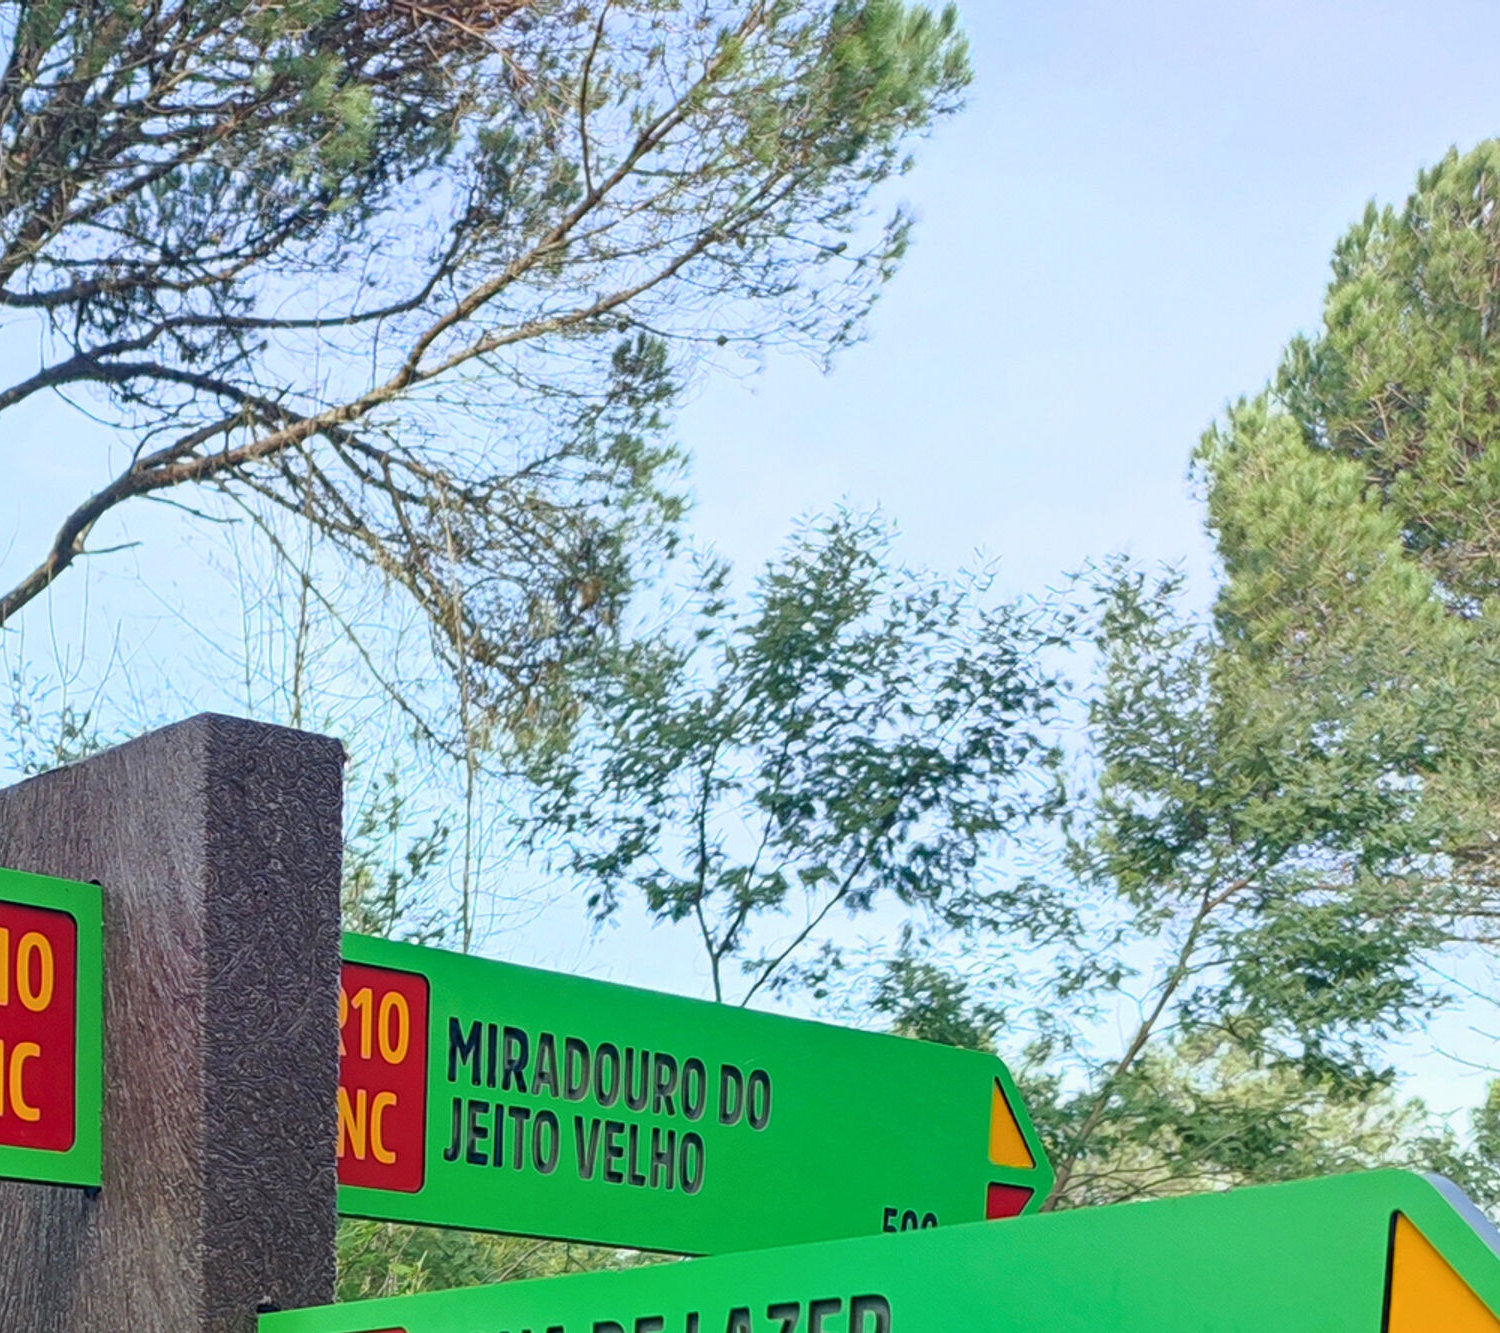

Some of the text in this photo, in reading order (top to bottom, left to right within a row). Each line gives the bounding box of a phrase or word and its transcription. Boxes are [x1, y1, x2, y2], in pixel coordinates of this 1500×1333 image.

[338, 986, 409, 1064] 10
[447, 1017, 772, 1131] MIRADOURO DO
[337, 1086, 397, 1164] NC
[443, 1097, 705, 1194] JEITO VELHO
